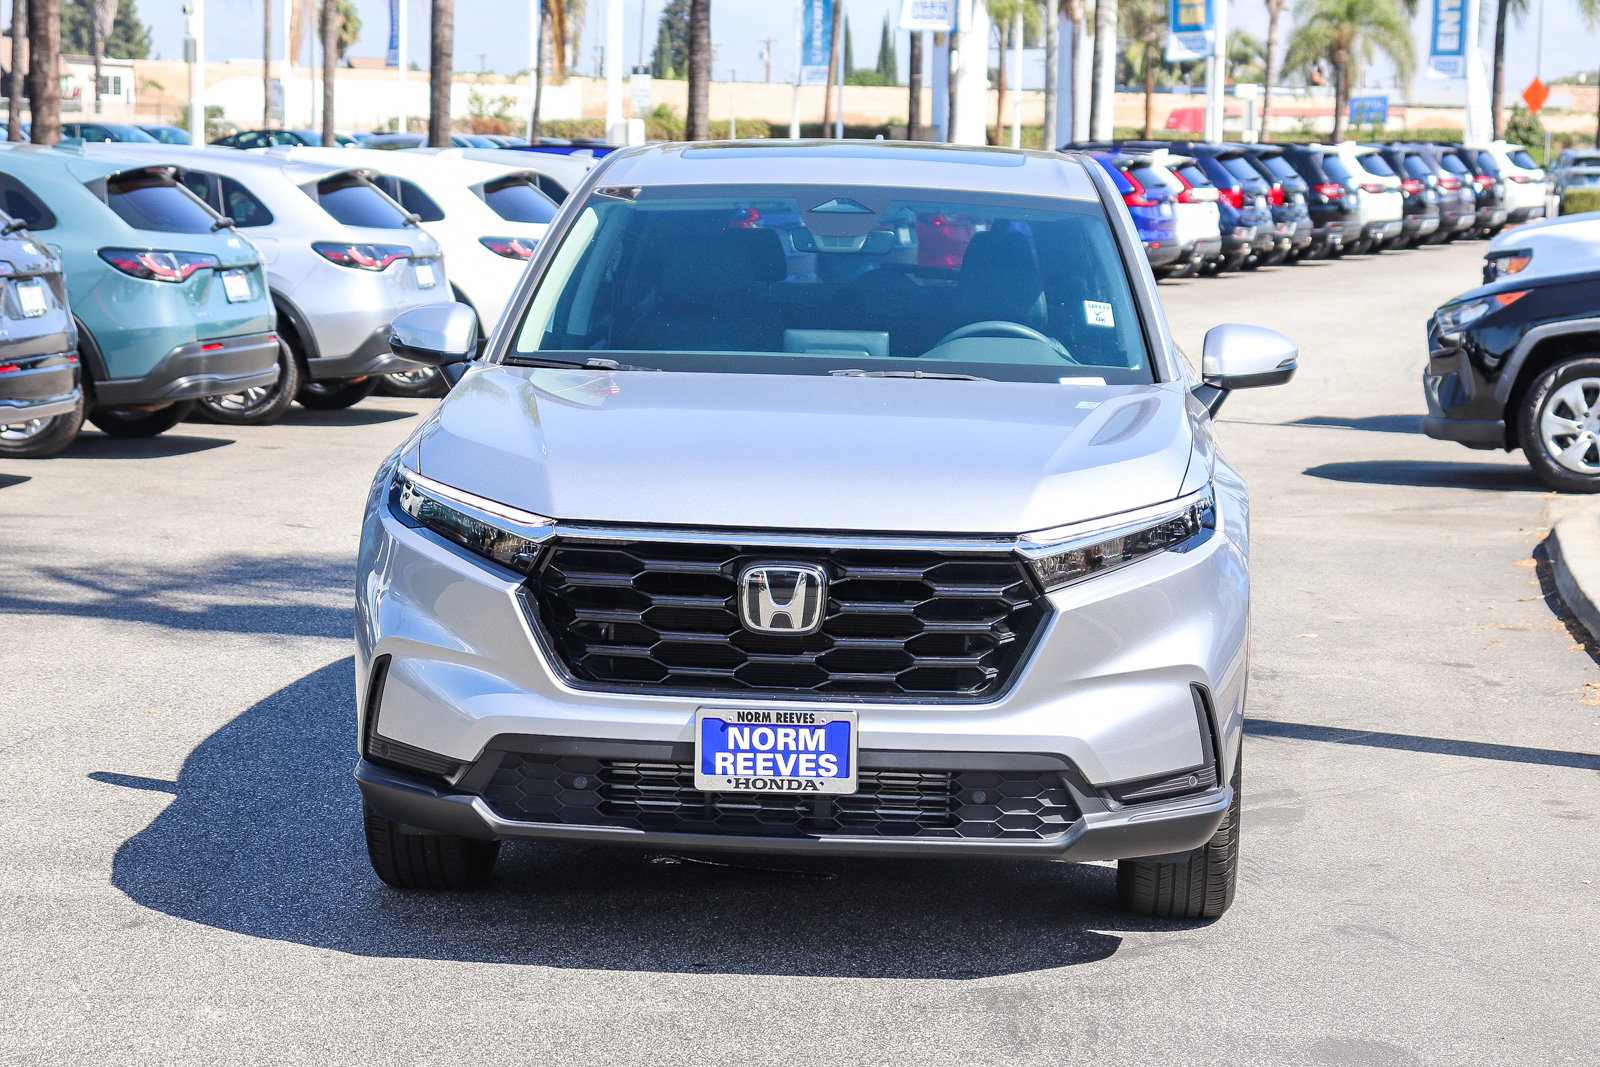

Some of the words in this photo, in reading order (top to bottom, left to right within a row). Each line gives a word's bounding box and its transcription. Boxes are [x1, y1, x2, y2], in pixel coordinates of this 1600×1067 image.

[737, 711, 771, 723] NORM
[775, 712, 816, 724] REEVES
[727, 727, 826, 752] NORM
[715, 752, 839, 778] REEVES
[733, 778, 821, 791] HONDA
